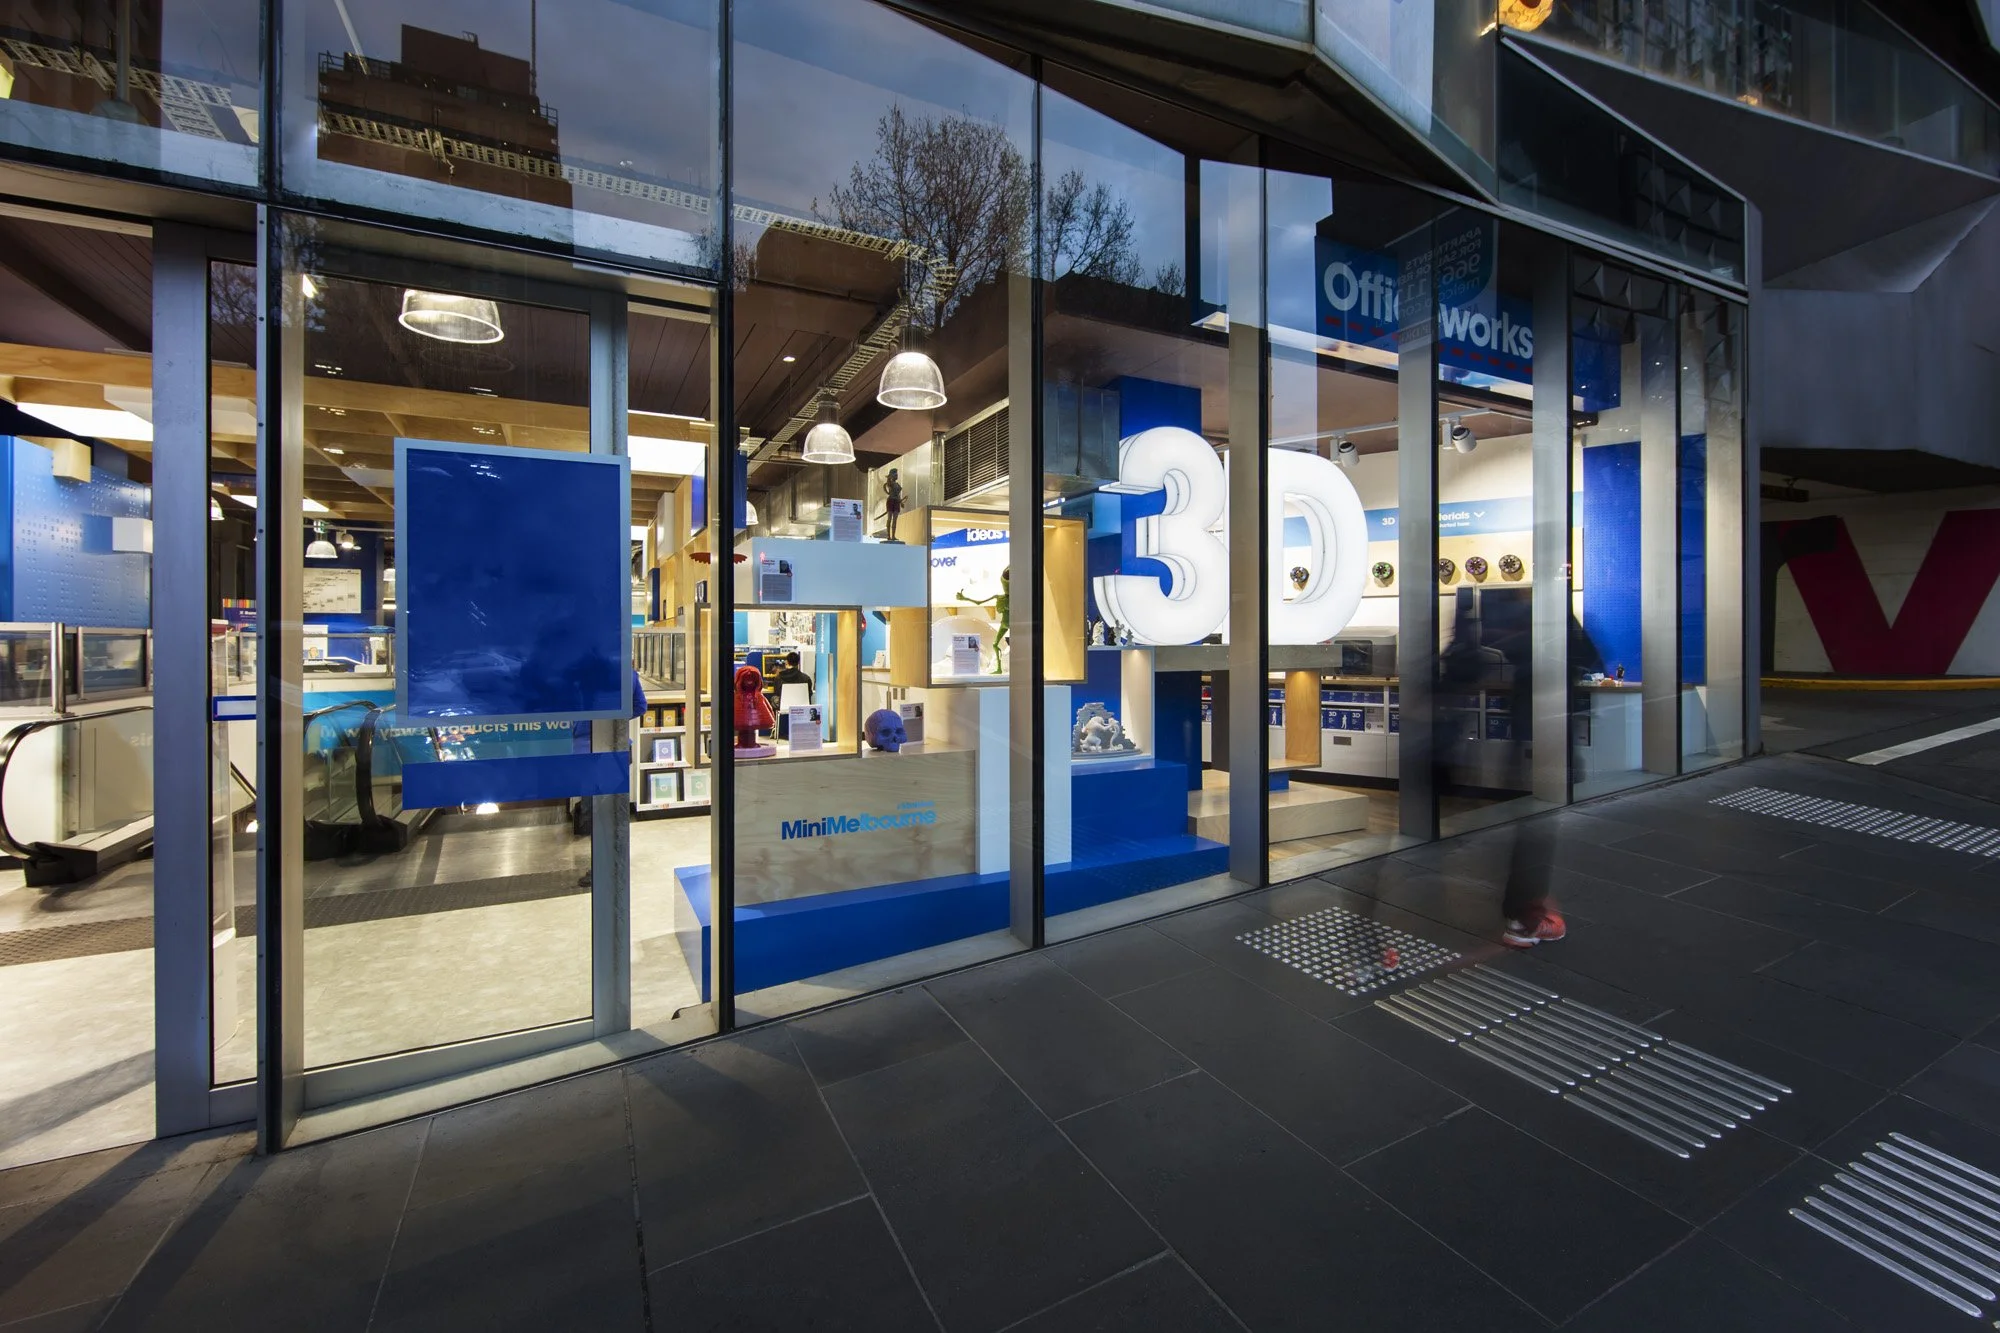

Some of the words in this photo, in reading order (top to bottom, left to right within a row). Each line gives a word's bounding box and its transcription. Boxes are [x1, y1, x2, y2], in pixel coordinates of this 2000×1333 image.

[1324, 262, 1532, 359] Offiworks
[1093, 426, 1368, 645] 3D
[1382, 517, 1395, 526] 3D
[781, 809, 938, 841] MiniMelbourne
